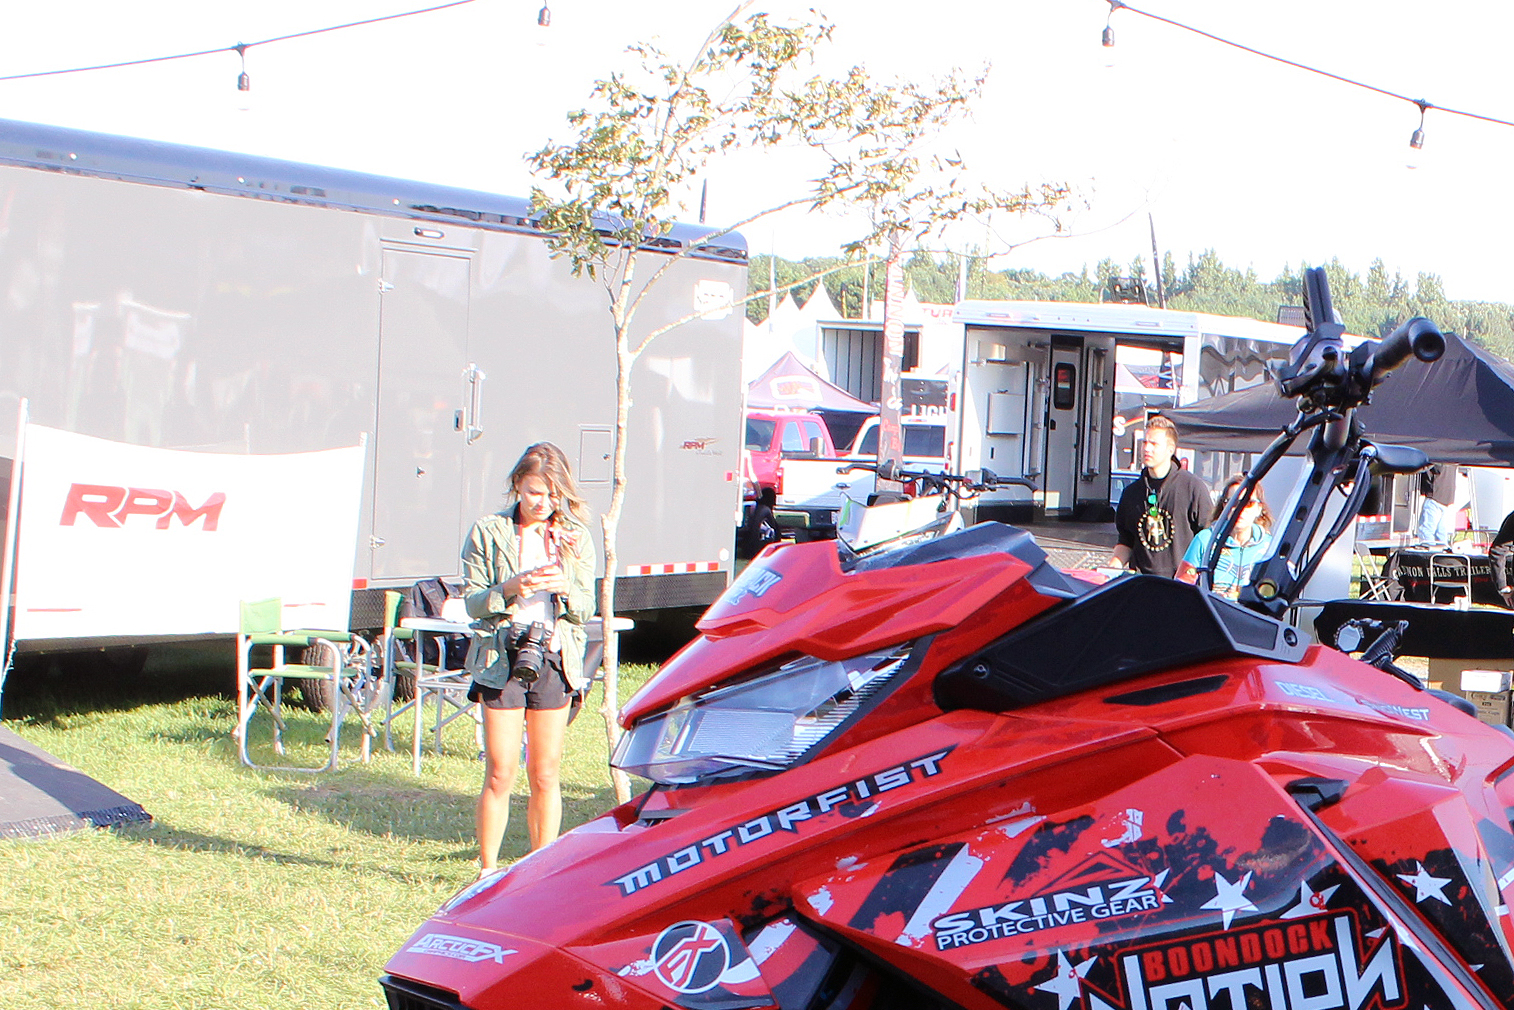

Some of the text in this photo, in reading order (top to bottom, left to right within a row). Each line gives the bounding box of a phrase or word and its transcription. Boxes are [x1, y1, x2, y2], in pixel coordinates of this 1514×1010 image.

[683, 441, 705, 450] RPM
[59, 481, 227, 533] RPM
[614, 751, 945, 895] MOTORFIST
[933, 876, 1158, 936] SKINZ
[938, 895, 1159, 951] PROTECTIVE GEAR
[1143, 917, 1334, 982] BOONDOCK
